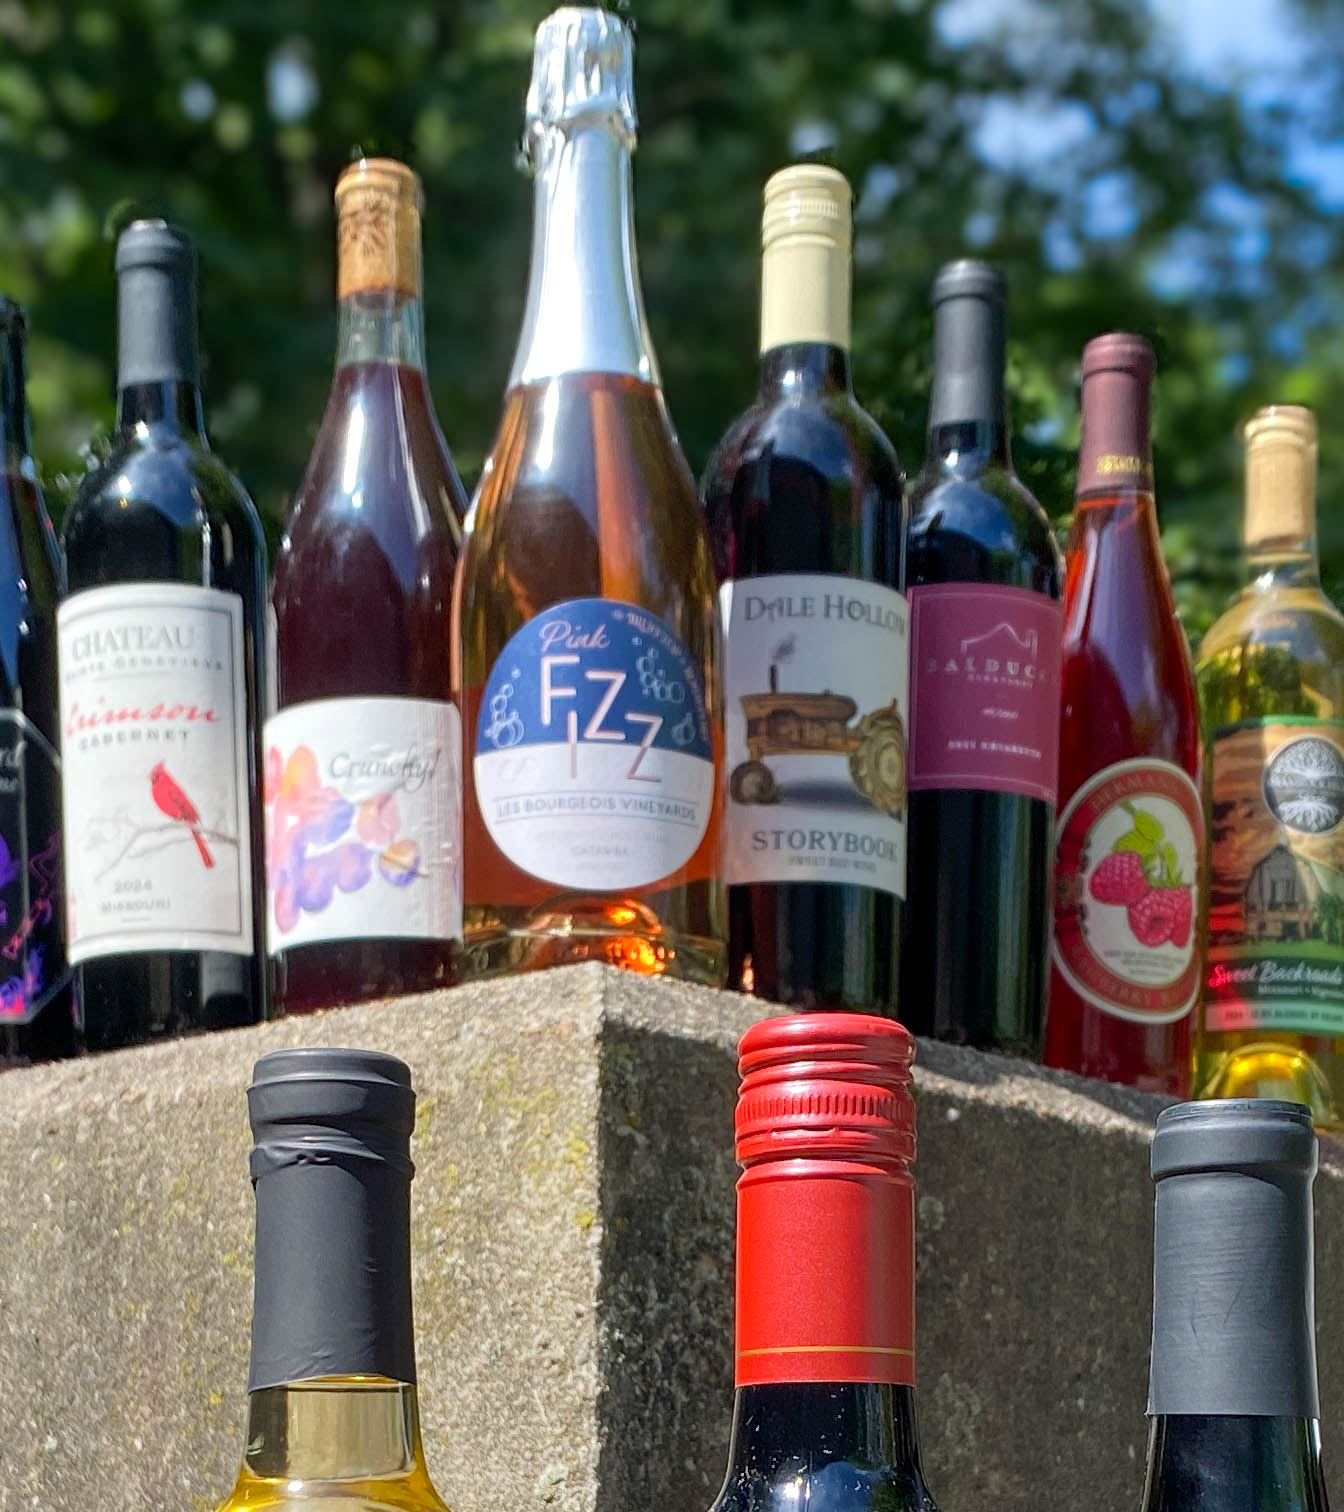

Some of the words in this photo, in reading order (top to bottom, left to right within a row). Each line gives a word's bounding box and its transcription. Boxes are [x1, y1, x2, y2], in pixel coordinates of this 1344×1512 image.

[744, 595, 816, 623] DALE
[71, 624, 196, 662] CHATEAU
[539, 620, 611, 654] Pink
[78, 727, 189, 751] CABERNET
[498, 801, 520, 818] LES
[524, 796, 617, 812] BOURGEOIS
[622, 797, 697, 821] VINEYARDS
[752, 829, 898, 864] STORYBOOK
